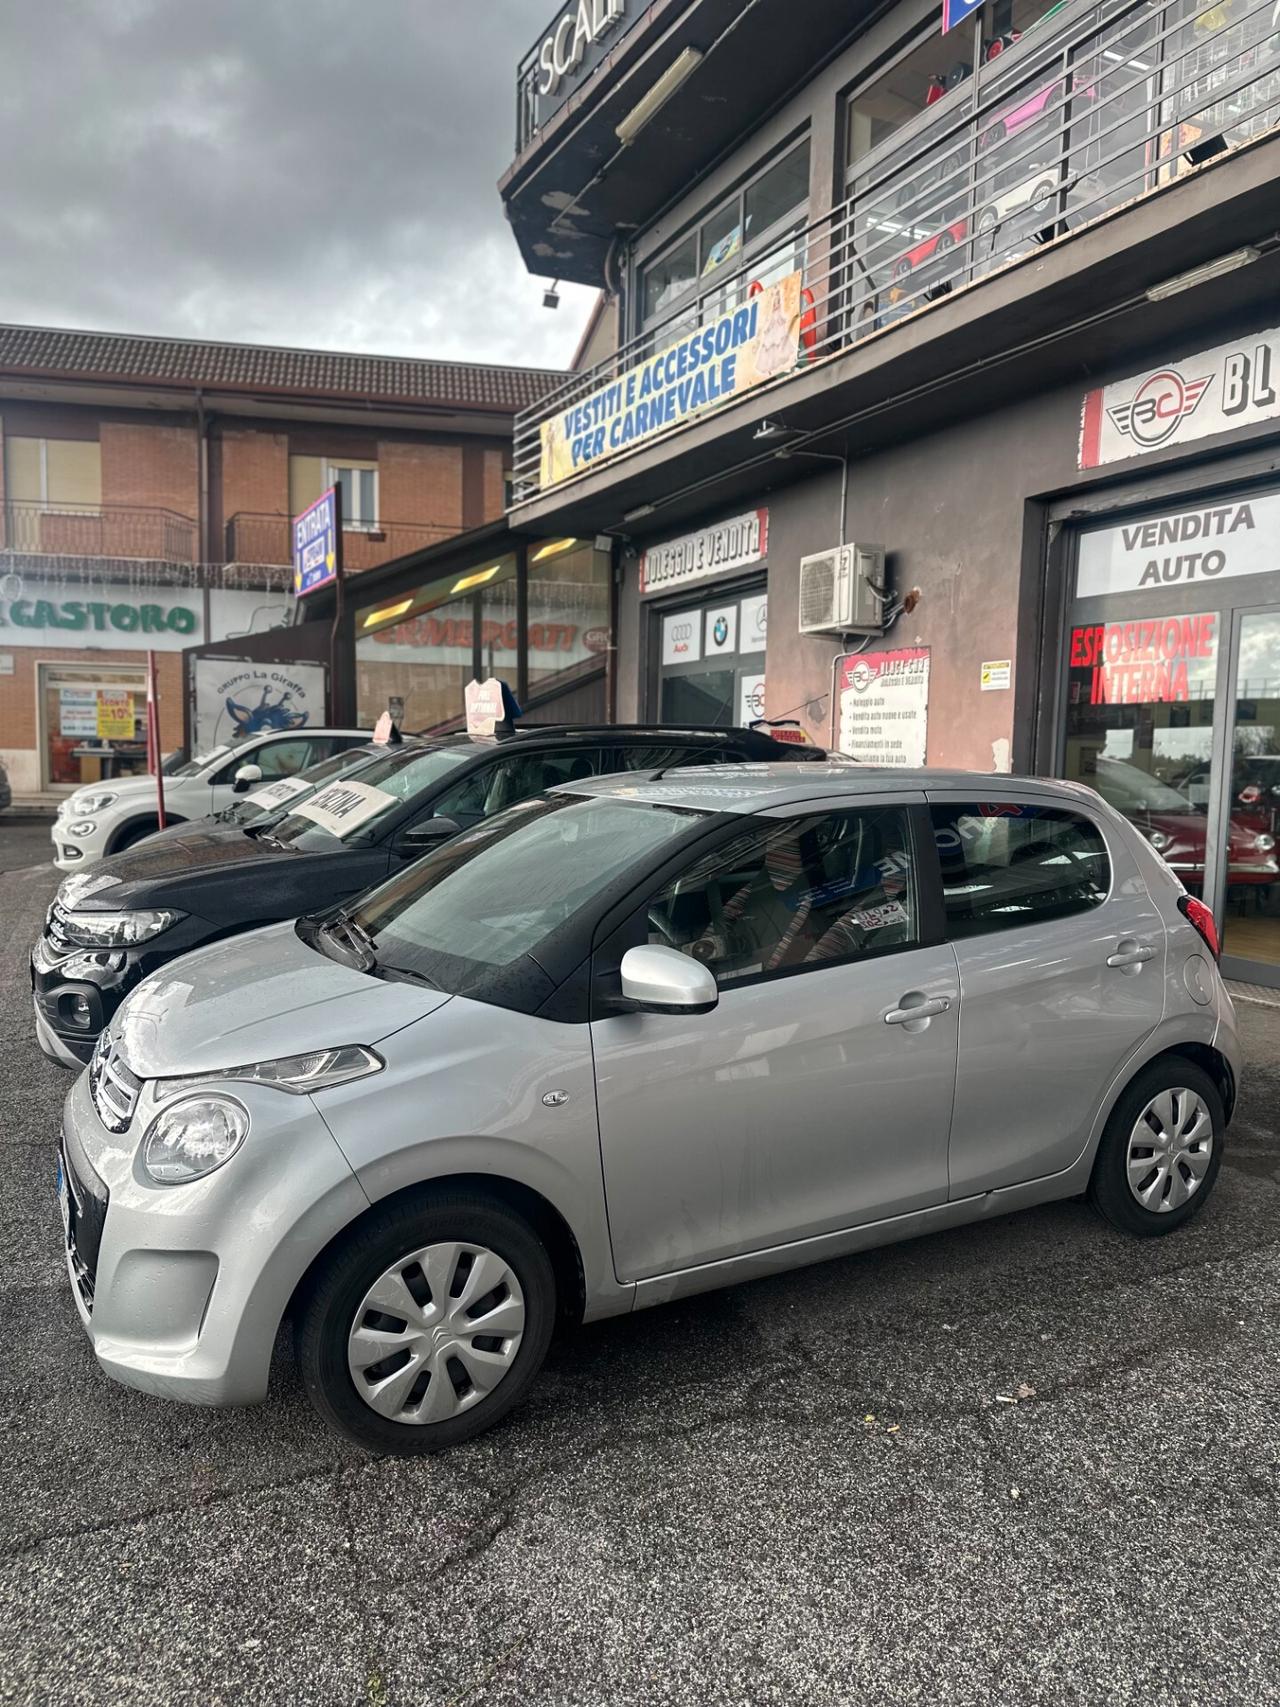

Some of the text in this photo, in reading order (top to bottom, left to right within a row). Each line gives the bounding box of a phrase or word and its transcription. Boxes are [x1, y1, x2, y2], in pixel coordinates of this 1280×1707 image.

[564, 302, 759, 440] VESTITI E ACCESSORI
[571, 353, 737, 467] PER CARNEVALE
[696, 537, 704, 570] E
[706, 518, 760, 567] VENDITA
[1121, 503, 1256, 552] VENDITA
[1137, 549, 1227, 586] AUTO
[9, 599, 196, 635] CASTORO
[1070, 613, 1217, 668] ESPOSIZIONE
[673, 642, 689, 653] Audi
[217, 670, 307, 699] GRUPPO La Giraffa
[1090, 660, 1190, 705] INTERNA
